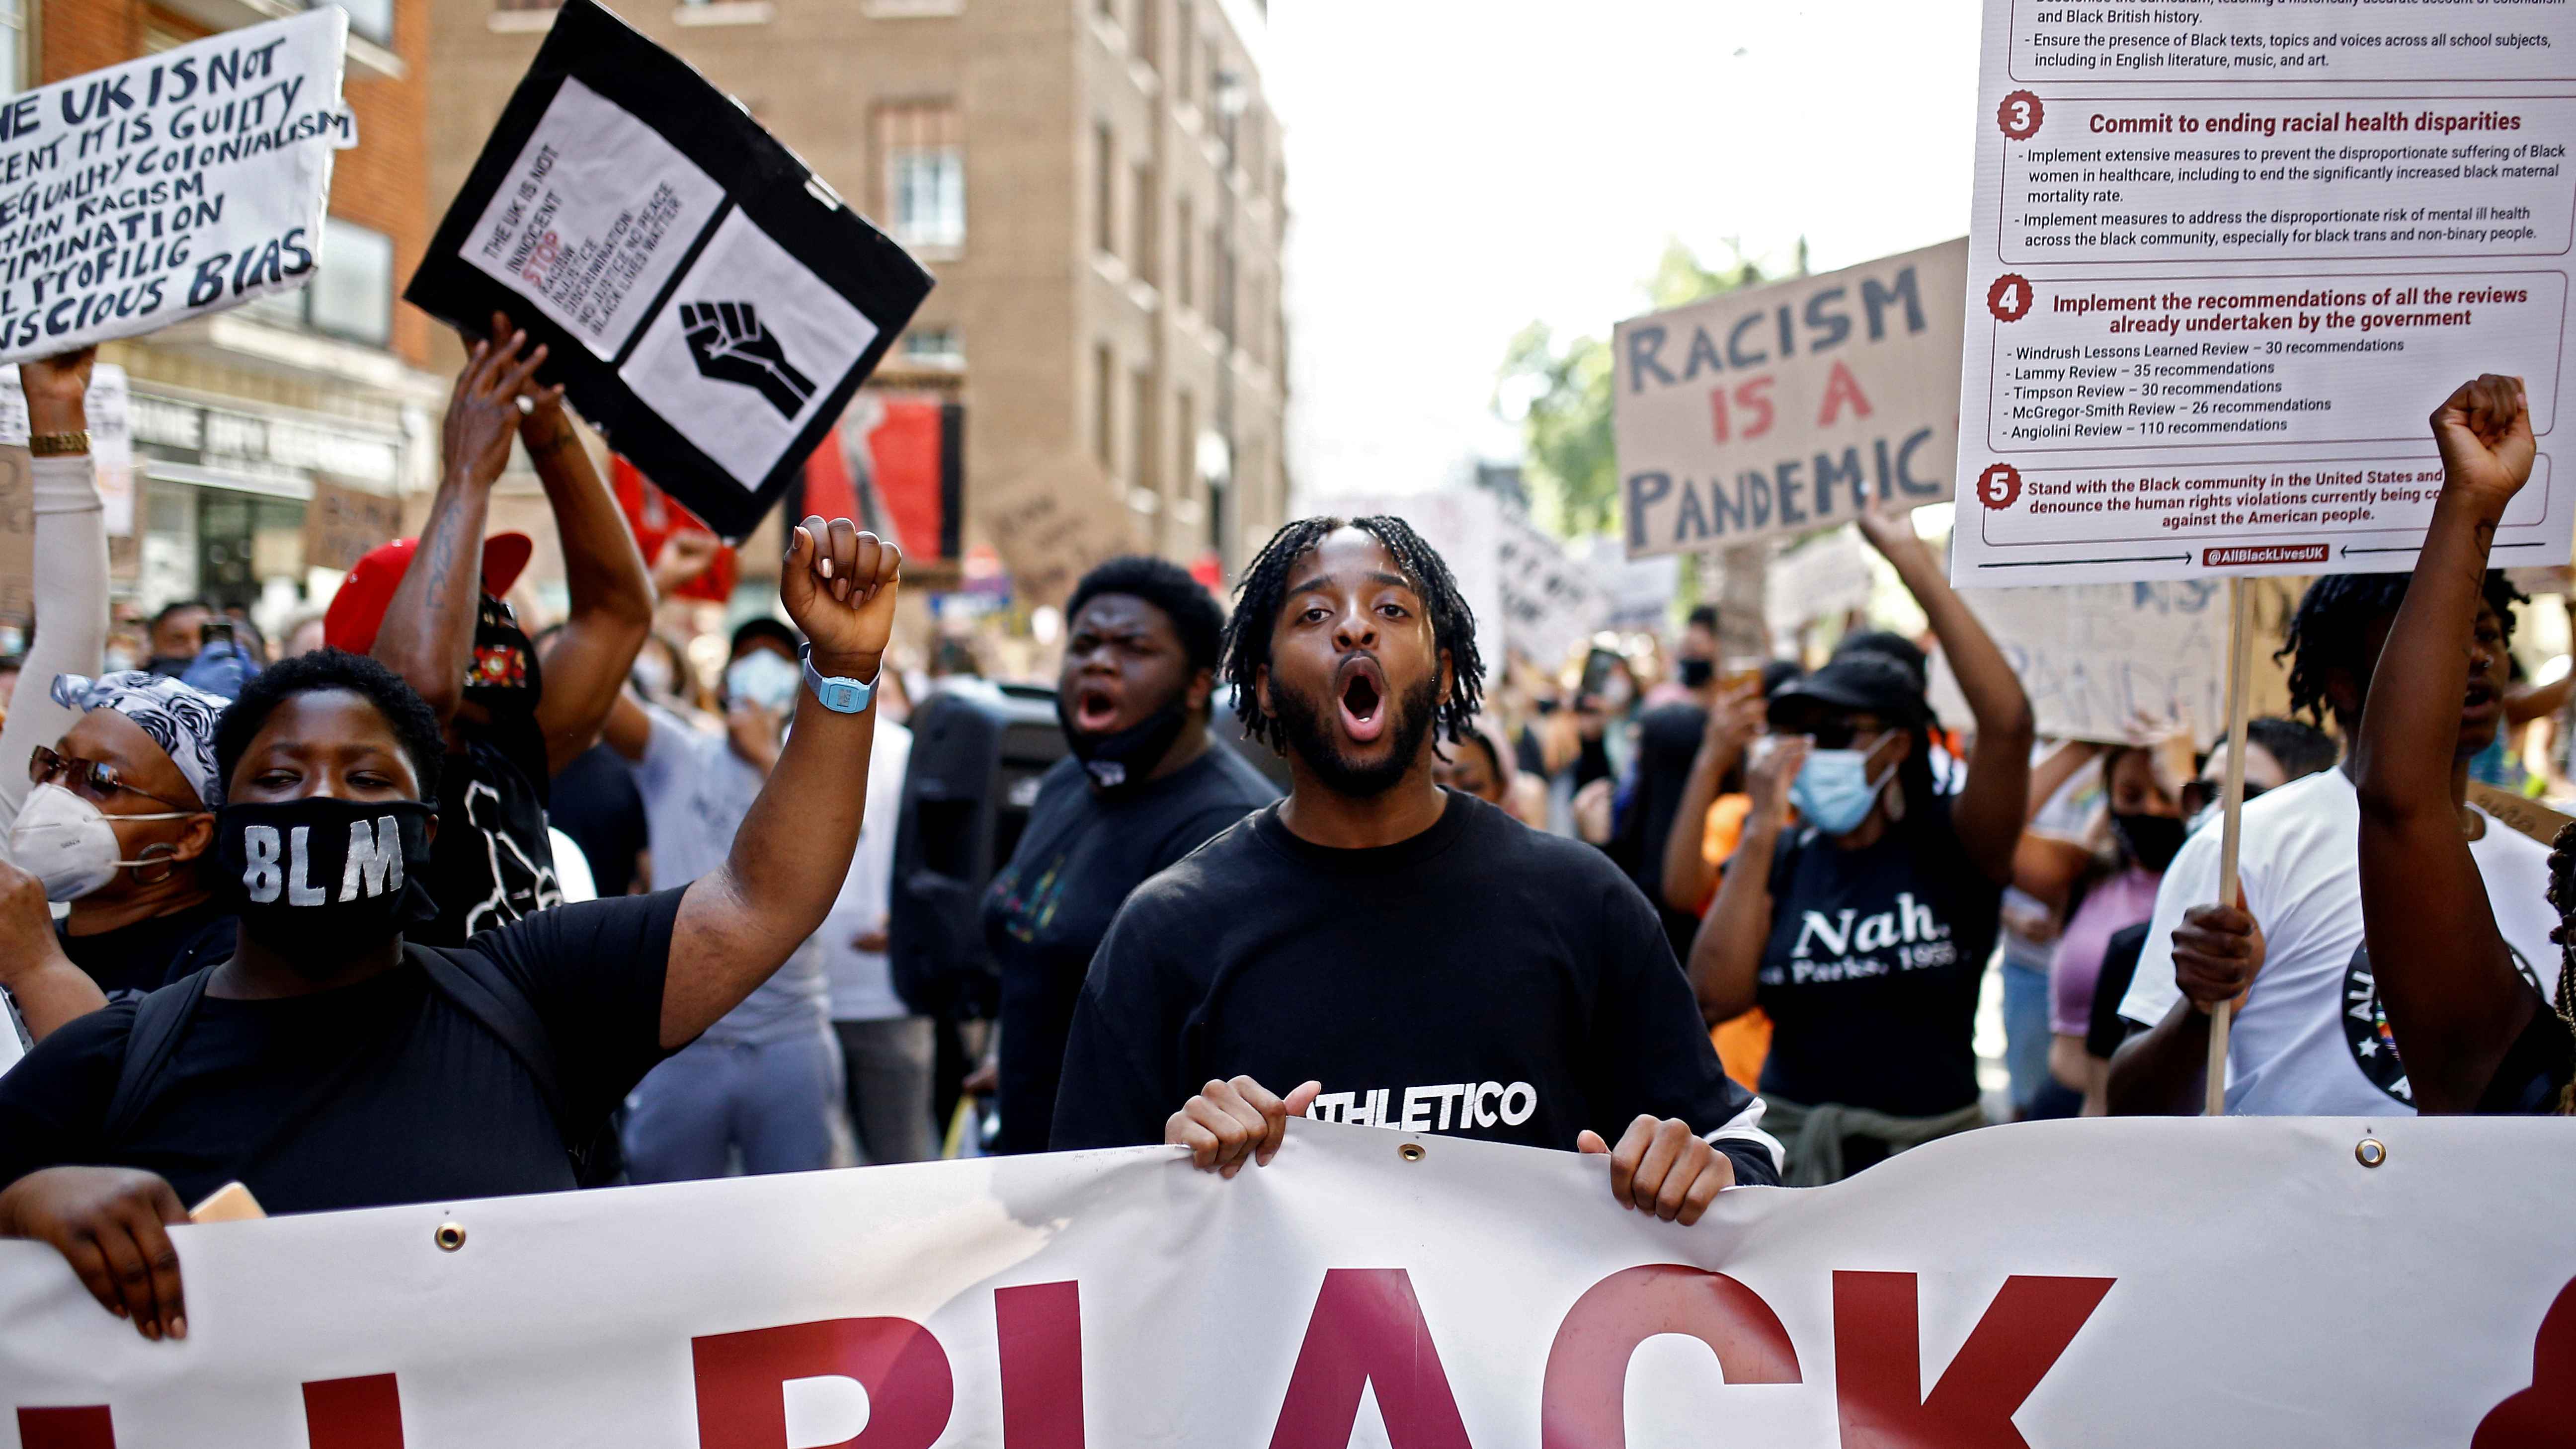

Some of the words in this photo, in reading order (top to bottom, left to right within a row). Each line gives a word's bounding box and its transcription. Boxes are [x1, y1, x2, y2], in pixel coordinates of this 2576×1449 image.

[2037, 9, 2062, 23] and
[2067, 9, 2103, 23] Black
[2107, 9, 2150, 23] British
[2154, 9, 2202, 26] history.
[2034, 33, 2080, 46] Ensure
[2084, 33, 2105, 46] the
[2109, 36, 2170, 49] presence
[2174, 33, 2187, 46] of
[2191, 33, 2227, 46] Black
[2231, 34, 2265, 49] texts,
[2270, 33, 2309, 50] topics
[2313, 33, 2337, 46] and
[2340, 34, 2381, 46] voices
[2385, 36, 2427, 46] across
[2431, 34, 2446, 46] all
[2450, 33, 2492, 46] school
[2496, 33, 2550, 49] subjects,
[2035, 53, 2096, 70] including
[2100, 53, 2112, 66] in
[2116, 53, 2164, 70] English
[2168, 53, 2230, 69] literature,
[2234, 53, 2276, 68] music,
[2280, 53, 2304, 66] and
[2308, 55, 2329, 66] art.
[61, 74, 136, 126] UK
[147, 58, 198, 108] IS
[207, 37, 287, 94] NOT
[78, 119, 114, 158] IT
[117, 111, 154, 149] IS
[170, 74, 305, 139] GUILTY
[2009, 100, 2031, 131] 3
[2090, 112, 2173, 133] Commit
[2178, 115, 2199, 133] to
[2205, 112, 2276, 136] ending
[2282, 112, 2339, 132] racial
[2345, 112, 2408, 131] health
[2415, 111, 2521, 135] disparities
[2028, 148, 2101, 165] Implement
[2105, 148, 2170, 161] extensive
[2174, 151, 2240, 161] measures
[2244, 149, 2257, 161] to
[2261, 148, 2310, 163] prevent
[2315, 147, 2335, 160] the
[2339, 146, 2447, 162] disproportionate
[2452, 145, 2509, 161] suffering
[2513, 145, 2526, 158] of
[2530, 145, 2565, 158] Black
[2029, 172, 2079, 182] women
[2083, 168, 2095, 182] in
[2099, 167, 2174, 183] healthcare,
[2178, 166, 2239, 183] including
[2243, 168, 2256, 180] to
[2260, 166, 2285, 180] end
[2288, 166, 2309, 180] the
[2313, 166, 2393, 182] significantly
[2397, 165, 2460, 178] increased
[2464, 165, 2497, 177] black
[2502, 164, 2559, 177] maternal
[76, 171, 204, 226] RACISM
[482, 224, 512, 259] THE
[502, 200, 522, 226] UK
[518, 180, 538, 202] IS
[529, 144, 559, 183] NOT
[2027, 188, 2090, 206] mortality
[2093, 189, 2123, 202] rate.
[0, 194, 224, 284] IMINATION
[506, 190, 561, 274] INNOCENT
[2025, 236, 2071, 246] across
[2075, 232, 2096, 245] the
[2100, 231, 2136, 245] black
[2140, 231, 2218, 247] community,
[2223, 229, 2289, 246] especially
[2293, 229, 2312, 242] for
[2315, 229, 2349, 242] black
[2353, 230, 2386, 241] trans
[2391, 228, 2415, 240] and
[2418, 228, 2487, 242] non-binary
[2490, 227, 2537, 242] people.
[187, 227, 314, 309] BIAS
[522, 230, 563, 289] STOP
[563, 212, 633, 314] DISCRIMINATION
[577, 305, 596, 323] NO
[593, 249, 631, 305] JUSTICE
[624, 229, 643, 251] NO
[637, 182, 673, 231] PEACE
[590, 290, 622, 336] BLACK
[618, 251, 648, 291] LIVES
[642, 197, 680, 251] MATTER
[537, 244, 575, 295] RACISM
[550, 238, 598, 304] INJUSTICE
[1999, 283, 2019, 314] 4
[2054, 293, 2157, 316] Implement
[2162, 292, 2192, 311] the
[2198, 289, 2366, 309] recommendations
[2372, 288, 2391, 306] of
[2396, 287, 2417, 305] all
[2423, 287, 2452, 304] the
[2458, 286, 2527, 304] reviews
[1627, 264, 1927, 396] RACISM
[2109, 314, 2180, 335] already
[2186, 312, 2293, 331] undertaken
[2298, 312, 2321, 332] by
[2326, 311, 2355, 328] the
[2361, 310, 2471, 331] government
[2016, 345, 2080, 360] Windrush
[2085, 345, 2140, 359] Lessons
[2145, 342, 2198, 357] Learned
[2202, 342, 2249, 356] Review
[2266, 341, 2282, 354] 30
[2286, 339, 2404, 353] recommendations
[1709, 375, 1776, 445] IS
[1817, 359, 1873, 429] A
[2011, 424, 2071, 441] Angiolini
[2075, 423, 2122, 437] Review
[2140, 421, 2164, 434] 110
[2168, 418, 2287, 434] recommendations
[1628, 426, 1943, 548] PANDEMIC
[1989, 471, 2009, 501] 5
[2028, 480, 2072, 495] Stand
[2076, 479, 2107, 494] with
[2111, 479, 2135, 493] the
[2139, 476, 2180, 492] Black
[2184, 474, 2267, 491] community
[2271, 474, 2284, 487] in
[2289, 473, 2311, 486] the
[2316, 471, 2362, 485] United
[2367, 471, 2412, 483] States
[2417, 470, 2443, 483] and
[2030, 500, 2103, 514] denounce
[2107, 496, 2131, 511] the
[2135, 496, 2184, 510] human
[2189, 493, 2232, 511] rights
[2237, 491, 2307, 506] violations
[2312, 488, 2377, 505] currently
[2381, 487, 2420, 503] being
[2208, 546, 2324, 565] @AllBlackLivesUK
[243, 815, 404, 907] BLM
